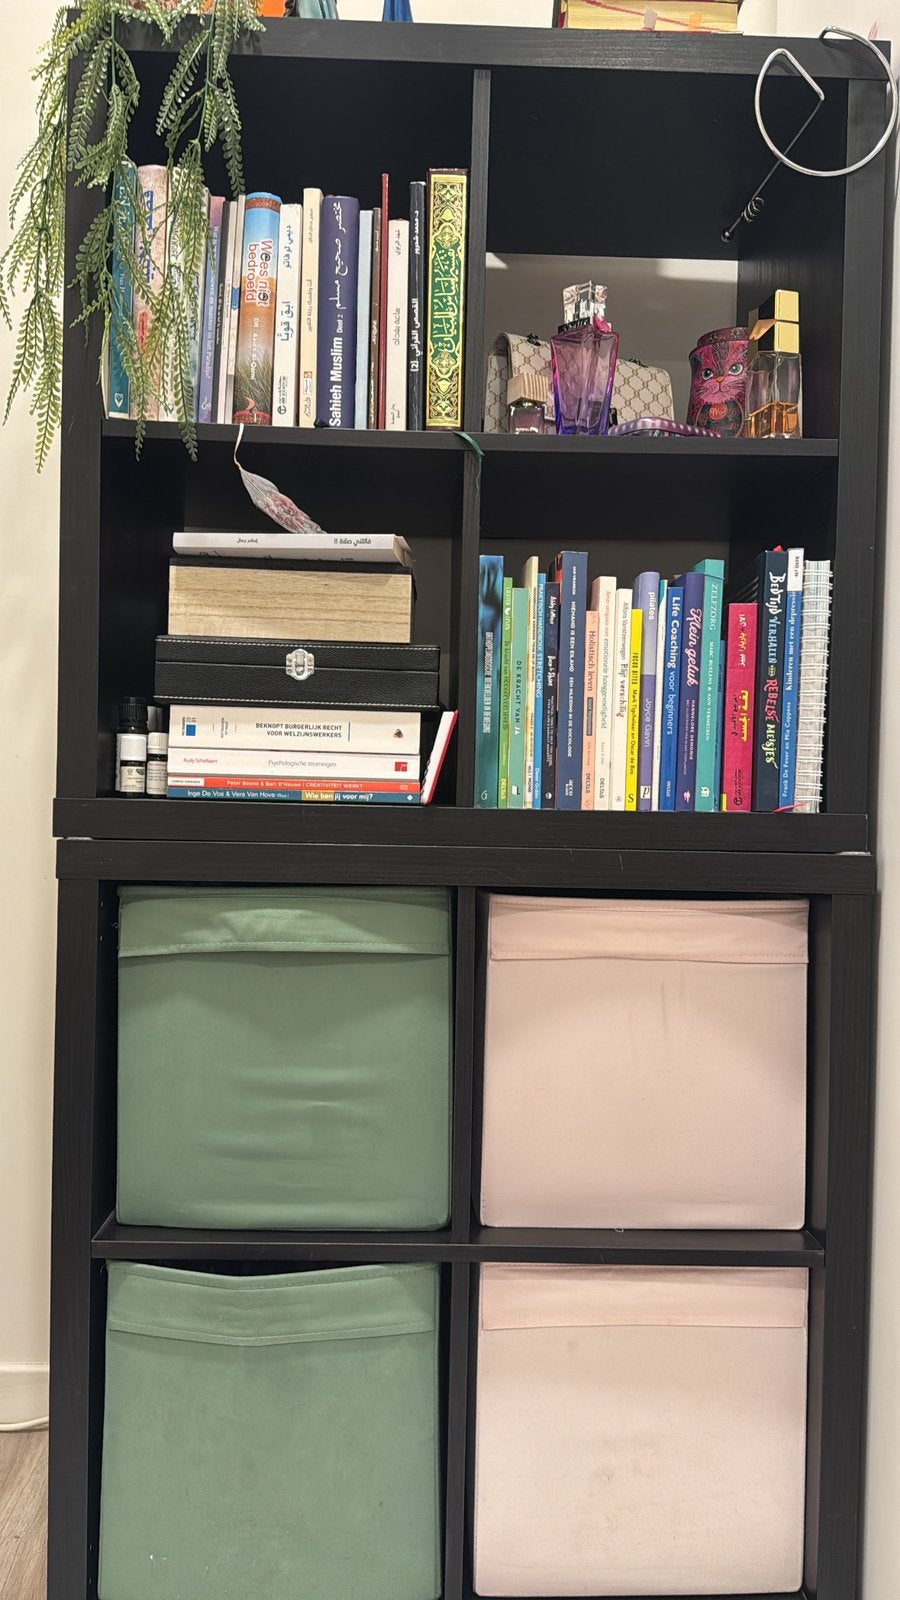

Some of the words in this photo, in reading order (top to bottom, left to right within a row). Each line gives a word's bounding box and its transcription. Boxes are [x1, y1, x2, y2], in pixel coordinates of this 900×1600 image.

[333, 202, 346, 234] مختصر
[246, 243, 259, 302] bedroefd
[260, 240, 273, 278] Wees
[334, 238, 348, 276] صحيح
[258, 280, 269, 307] niet
[328, 280, 346, 310] مسلم
[330, 336, 343, 382] Muslim
[410, 360, 419, 373] (2)
[329, 385, 342, 427] Sahieh
[648, 592, 657, 620] pilates
[671, 596, 680, 617] Life
[710, 584, 719, 630] ZELFZORG
[620, 620, 628, 660] Vansteenwegen
[667, 620, 680, 668] Coaching
[686, 608, 702, 648] Klein
[768, 616, 781, 664] VERHALEN
[516, 660, 522, 670] DE
[588, 630, 596, 668] Holistisch
[536, 652, 544, 698] STRETCHING
[685, 648, 699, 687] geluk
[786, 657, 794, 691] Kinderen
[600, 675, 608, 729] hooggevoeligheid
[644, 698, 652, 722] Joyce
[665, 694, 676, 735] beginners
[738, 690, 749, 712] لغة
[764, 679, 780, 723] REBELSE
[514, 726, 520, 736] JA
[644, 724, 652, 748] Gavin
[738, 712, 750, 742] الجسد
[785, 742, 790, 750] en
[268, 760, 306, 768] Psychologische
[783, 769, 788, 778] De
[359, 794, 374, 802] mij?
